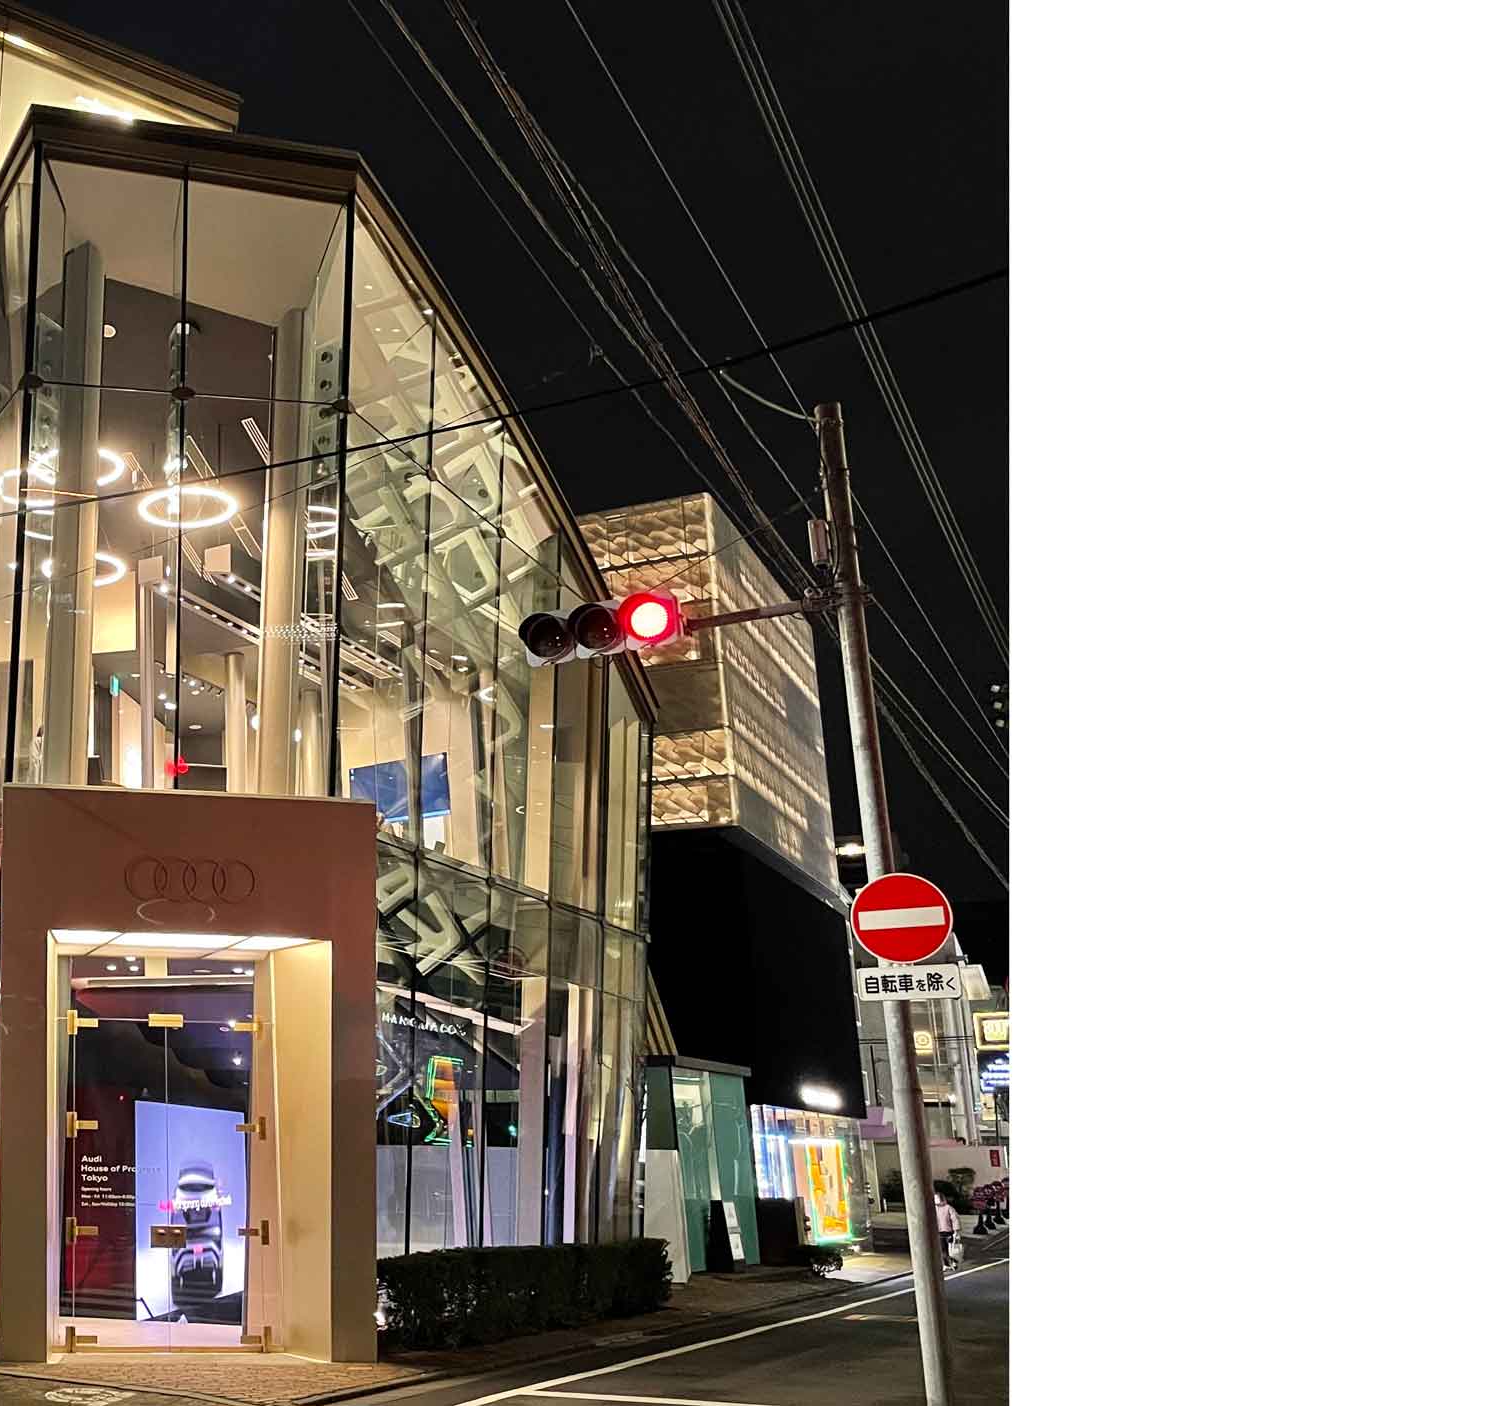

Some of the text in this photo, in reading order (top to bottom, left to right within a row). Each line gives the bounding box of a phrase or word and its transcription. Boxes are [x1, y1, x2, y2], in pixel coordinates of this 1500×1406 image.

[865, 972, 956, 994] 自転車を除く
[81, 1155, 102, 1163] Audi
[81, 1174, 108, 1183] Tokyo
